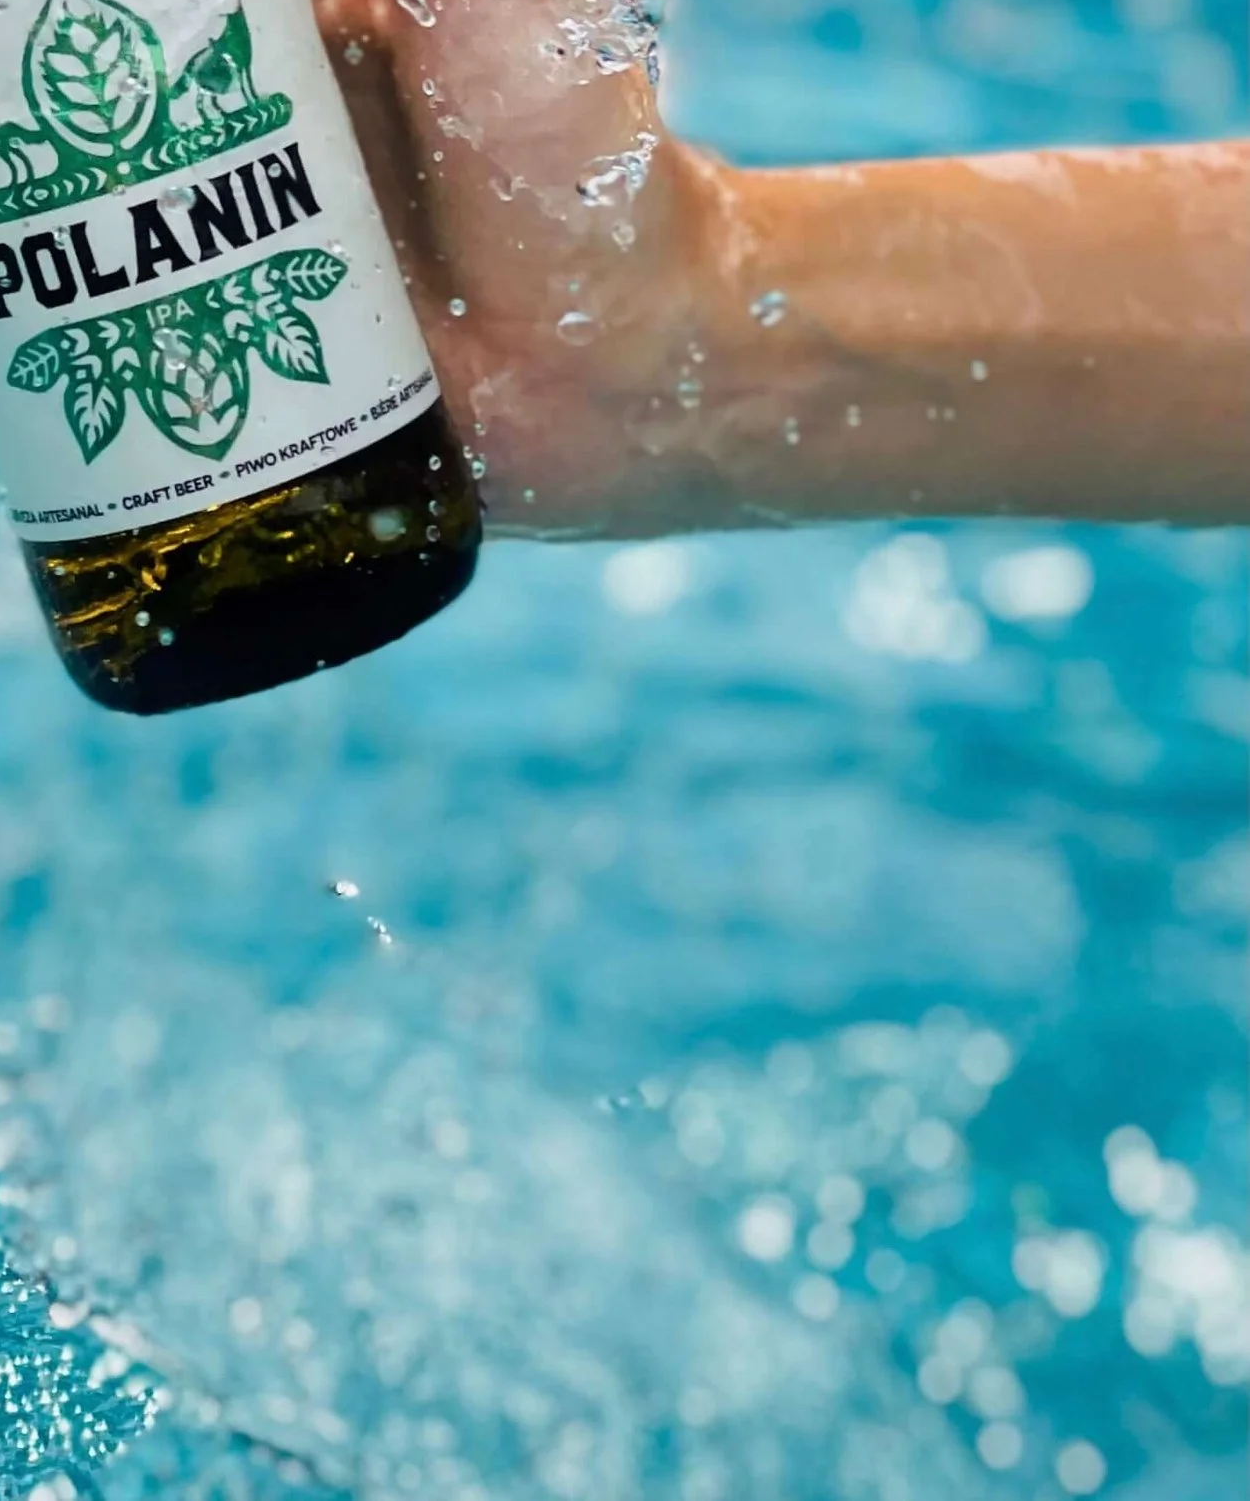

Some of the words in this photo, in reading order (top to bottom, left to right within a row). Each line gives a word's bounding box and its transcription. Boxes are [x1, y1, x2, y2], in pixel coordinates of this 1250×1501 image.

[146, 300, 196, 330] IPA
[38, 504, 104, 524] ARTESANAL
[122, 486, 172, 511] CRAFT
[174, 474, 215, 498] BEER
[235, 452, 277, 478] PIWO
[279, 418, 359, 461] KRAFTOWE
